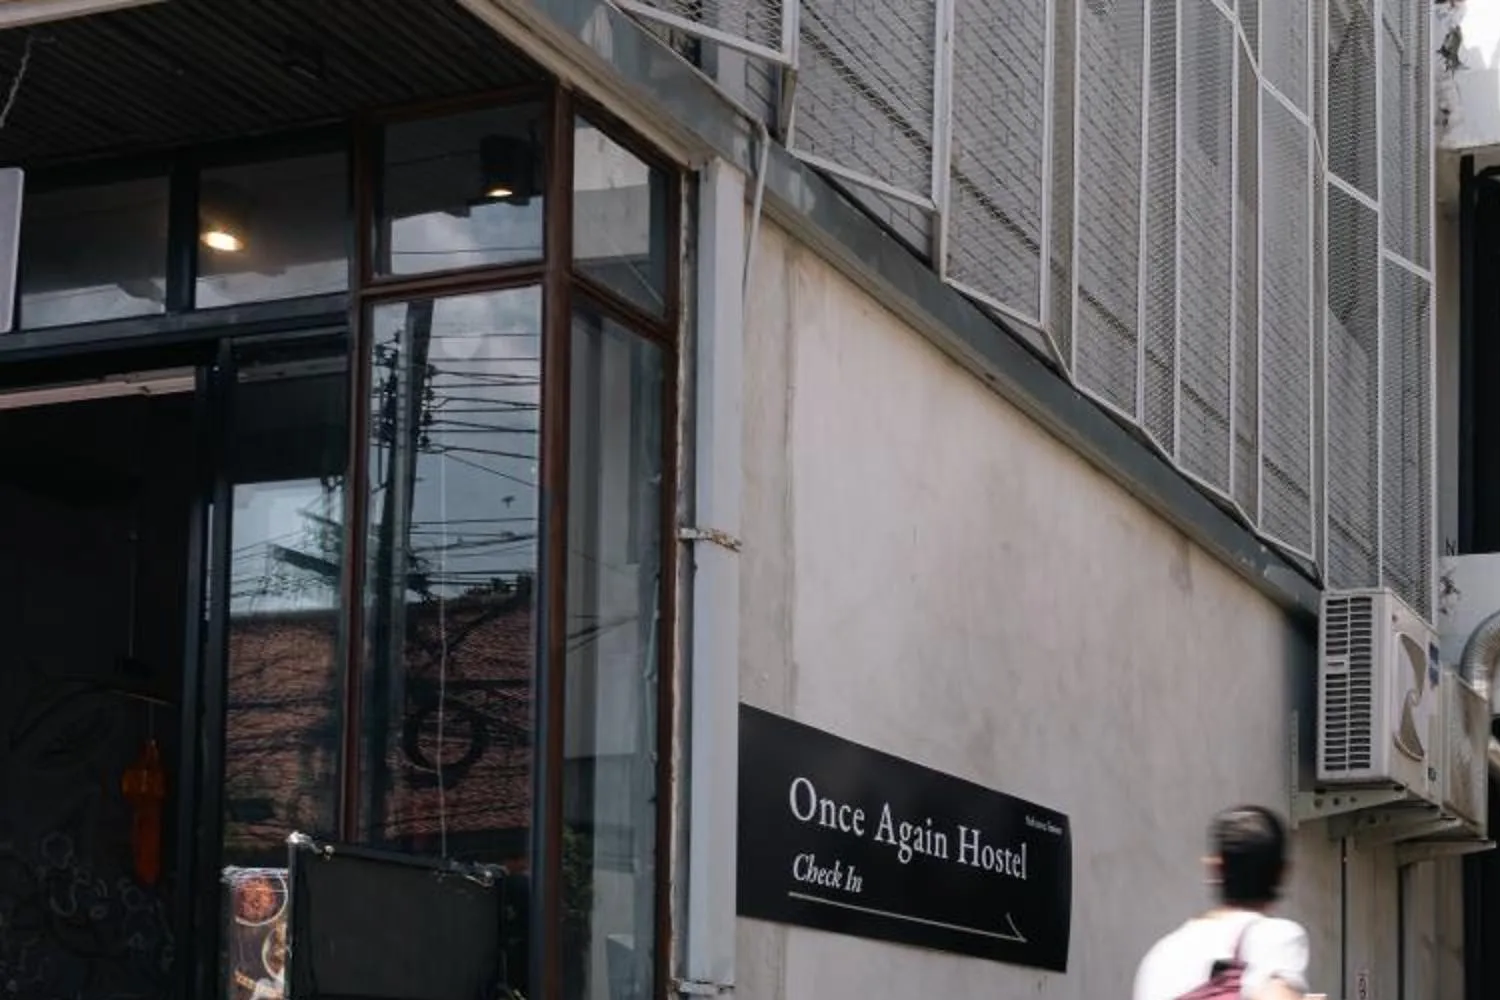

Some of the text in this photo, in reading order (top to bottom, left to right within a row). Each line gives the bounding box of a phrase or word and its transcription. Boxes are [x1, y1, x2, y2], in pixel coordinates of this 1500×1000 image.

[789, 777, 1027, 880] Once Again Hostel
[793, 853, 863, 893] Check In
